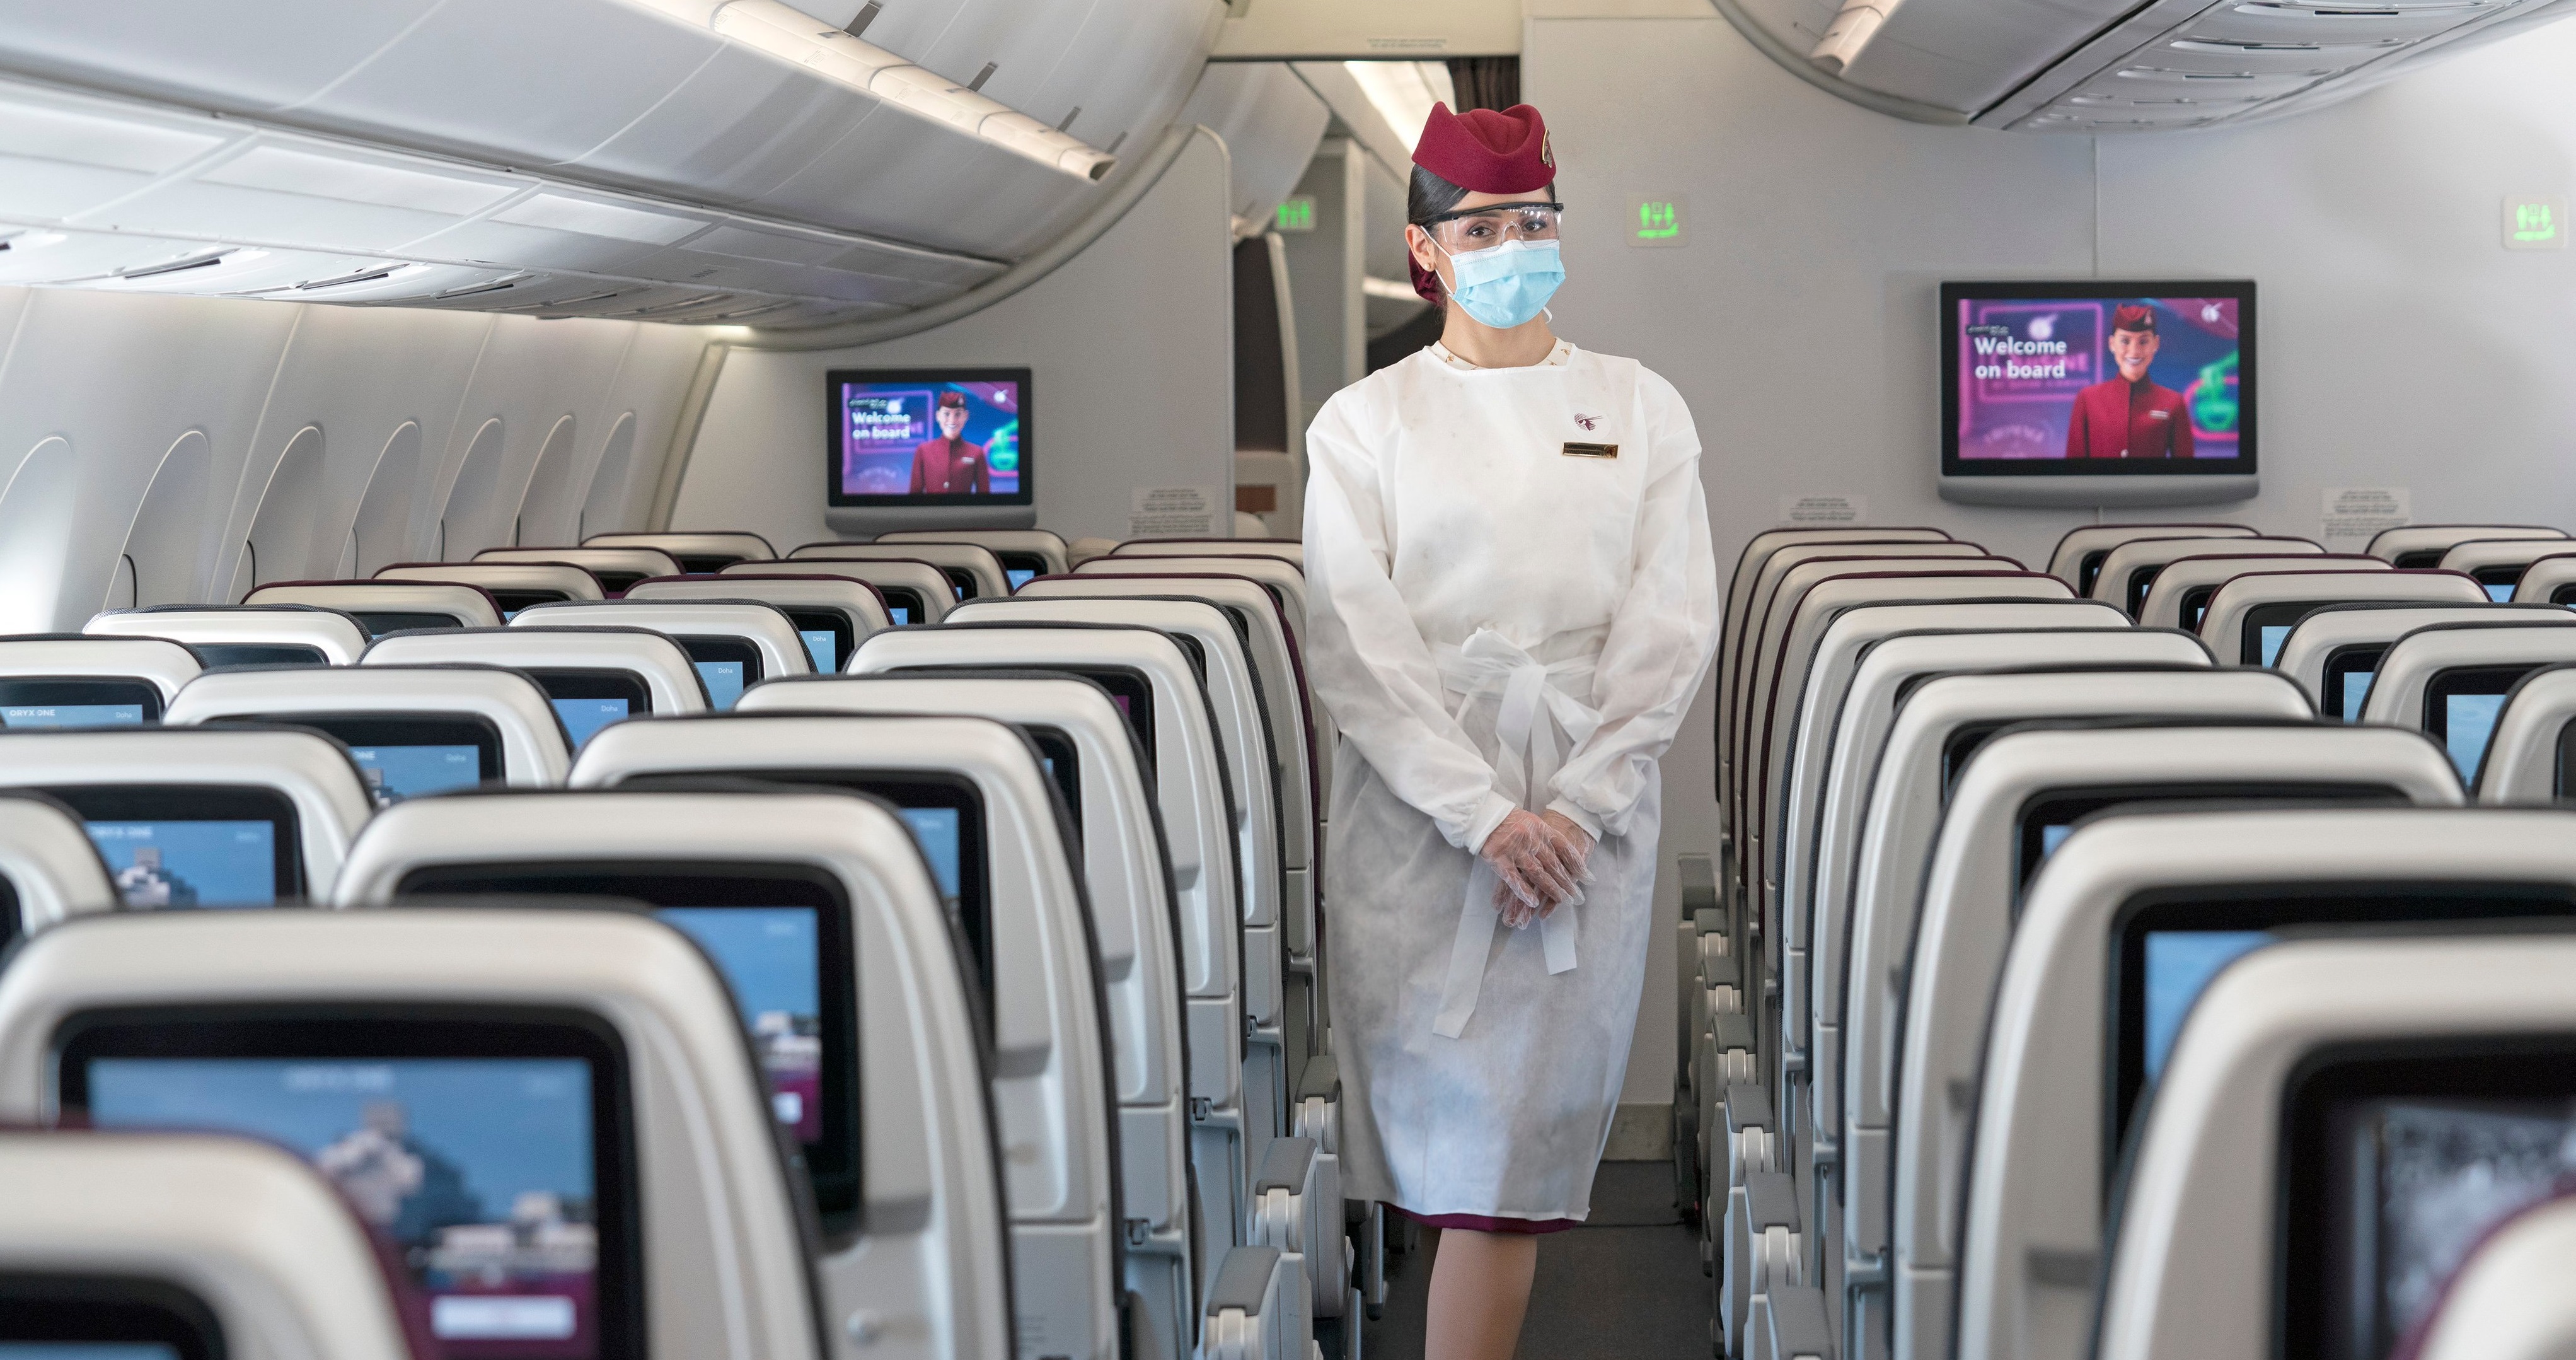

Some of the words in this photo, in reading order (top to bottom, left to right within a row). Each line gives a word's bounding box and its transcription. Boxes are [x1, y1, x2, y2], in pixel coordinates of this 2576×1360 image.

[1975, 336, 2067, 355] Welcome
[1975, 364, 2001, 378] on
[2007, 359, 2065, 378] board
[852, 411, 911, 425] Welcome
[853, 429, 870, 439] on
[872, 426, 911, 439] board
